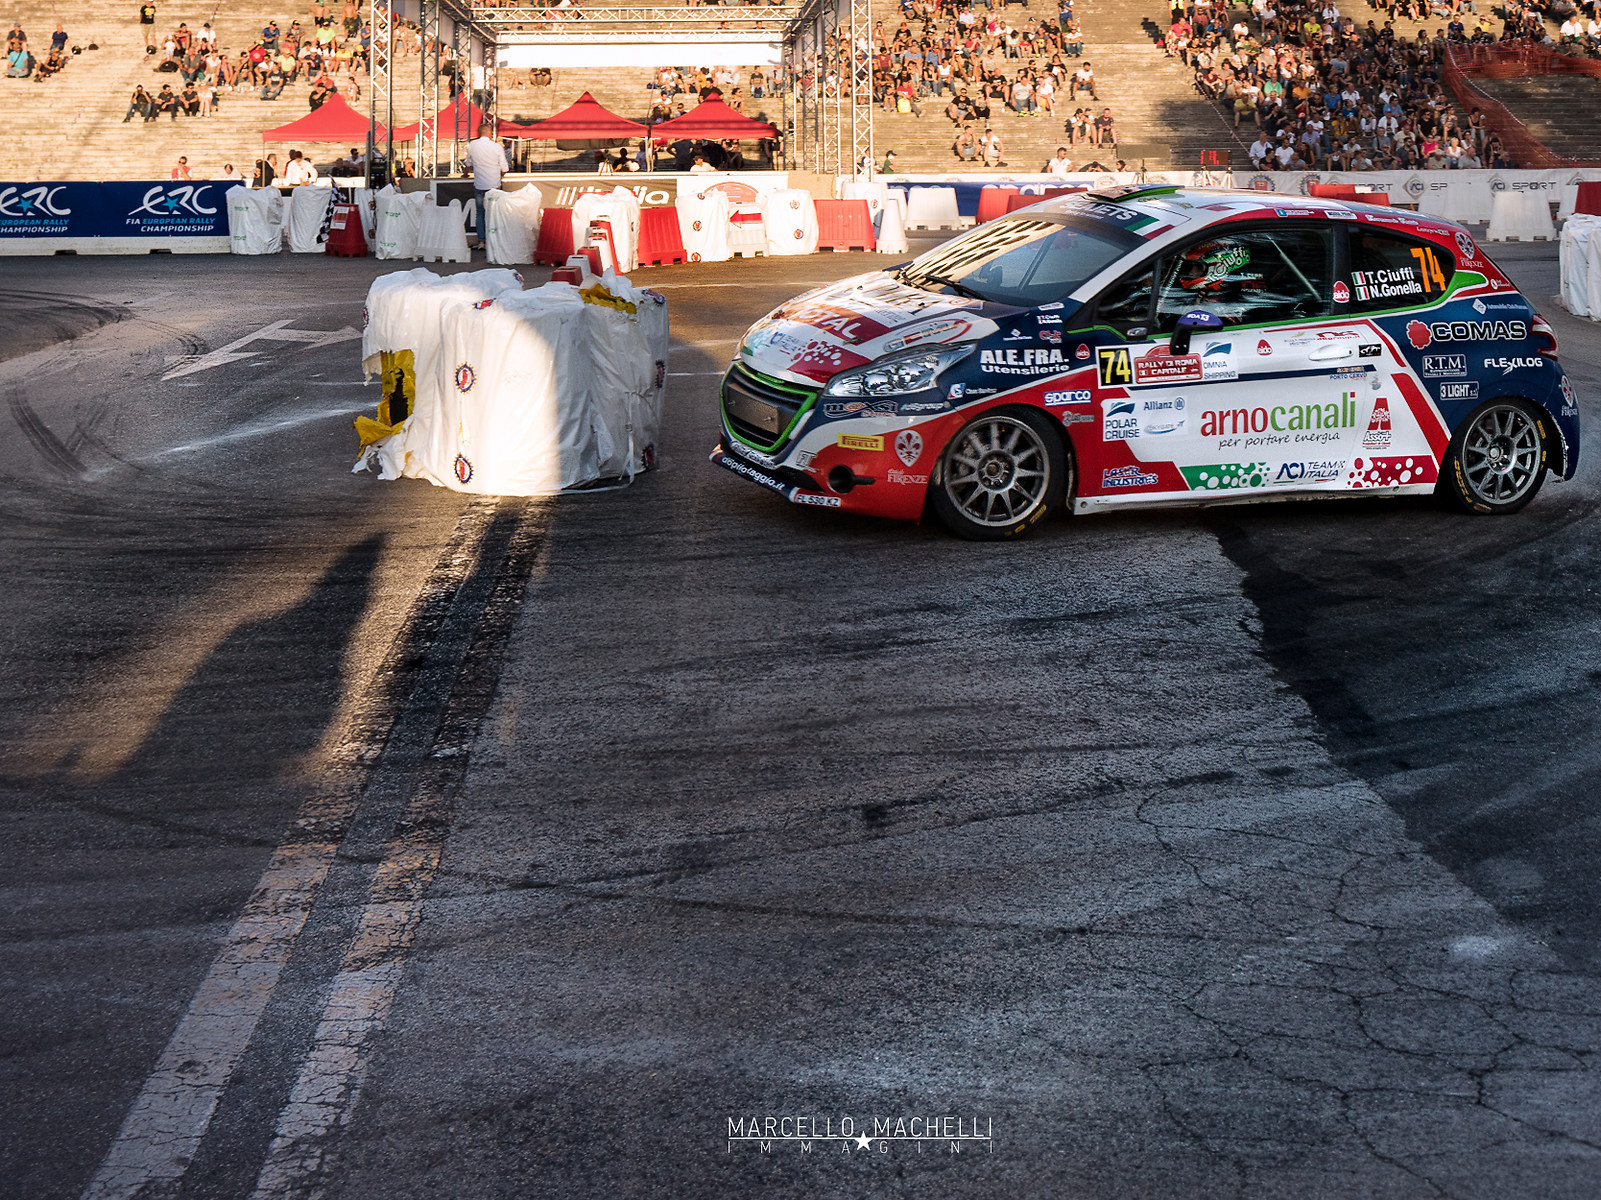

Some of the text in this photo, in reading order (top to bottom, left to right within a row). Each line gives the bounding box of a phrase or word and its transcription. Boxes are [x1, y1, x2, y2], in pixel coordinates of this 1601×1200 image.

[1410, 182, 1425, 193] ACI
[1490, 182, 1507, 193] ACI
[1512, 181, 1556, 193] SPORT
[128, 185, 218, 216] ERC
[43, 218, 70, 226] RALLY
[194, 217, 216, 225] RALLY
[140, 224, 214, 232] CHAMPIONSHIP
[1365, 267, 1415, 285] T.Ciuffi
[1410, 247, 1446, 293] 74
[1333, 291, 1350, 299] aido
[1370, 280, 1423, 299] N.Gonella
[800, 306, 863, 339] OTAL
[1430, 320, 1527, 342] COMAS
[980, 348, 1070, 366] ALE.FRA.
[1424, 356, 1466, 370] R.T.M.
[981, 363, 1071, 376] Utensilerie
[1100, 350, 1131, 384] 74
[1138, 361, 1163, 370] RALLY
[1176, 358, 1199, 366] ROMA
[1203, 361, 1228, 369] OMNIA
[1484, 357, 1543, 375] FLEXILOG
[1151, 367, 1187, 375] CAPITALE
[1204, 371, 1237, 380] SHIPPING
[1441, 385, 1447, 397] 3
[1448, 384, 1470, 397] LIGHT
[1045, 391, 1091, 404] sparco
[1144, 400, 1173, 410] Allianz
[1200, 391, 1356, 437] arnocanali
[1105, 418, 1138, 429] POLAR
[1105, 429, 1140, 440] CRUISE
[1219, 431, 1341, 450] per portare energia
[842, 435, 879, 448] PIRELLI
[1276, 462, 1305, 480] ACI
[1308, 461, 1338, 469] TEAM
[1103, 466, 1141, 478] LASER
[1304, 469, 1339, 478] ITALIA
[887, 473, 928, 486] FIRENZE
[1102, 474, 1158, 488] INDUSTRIES
